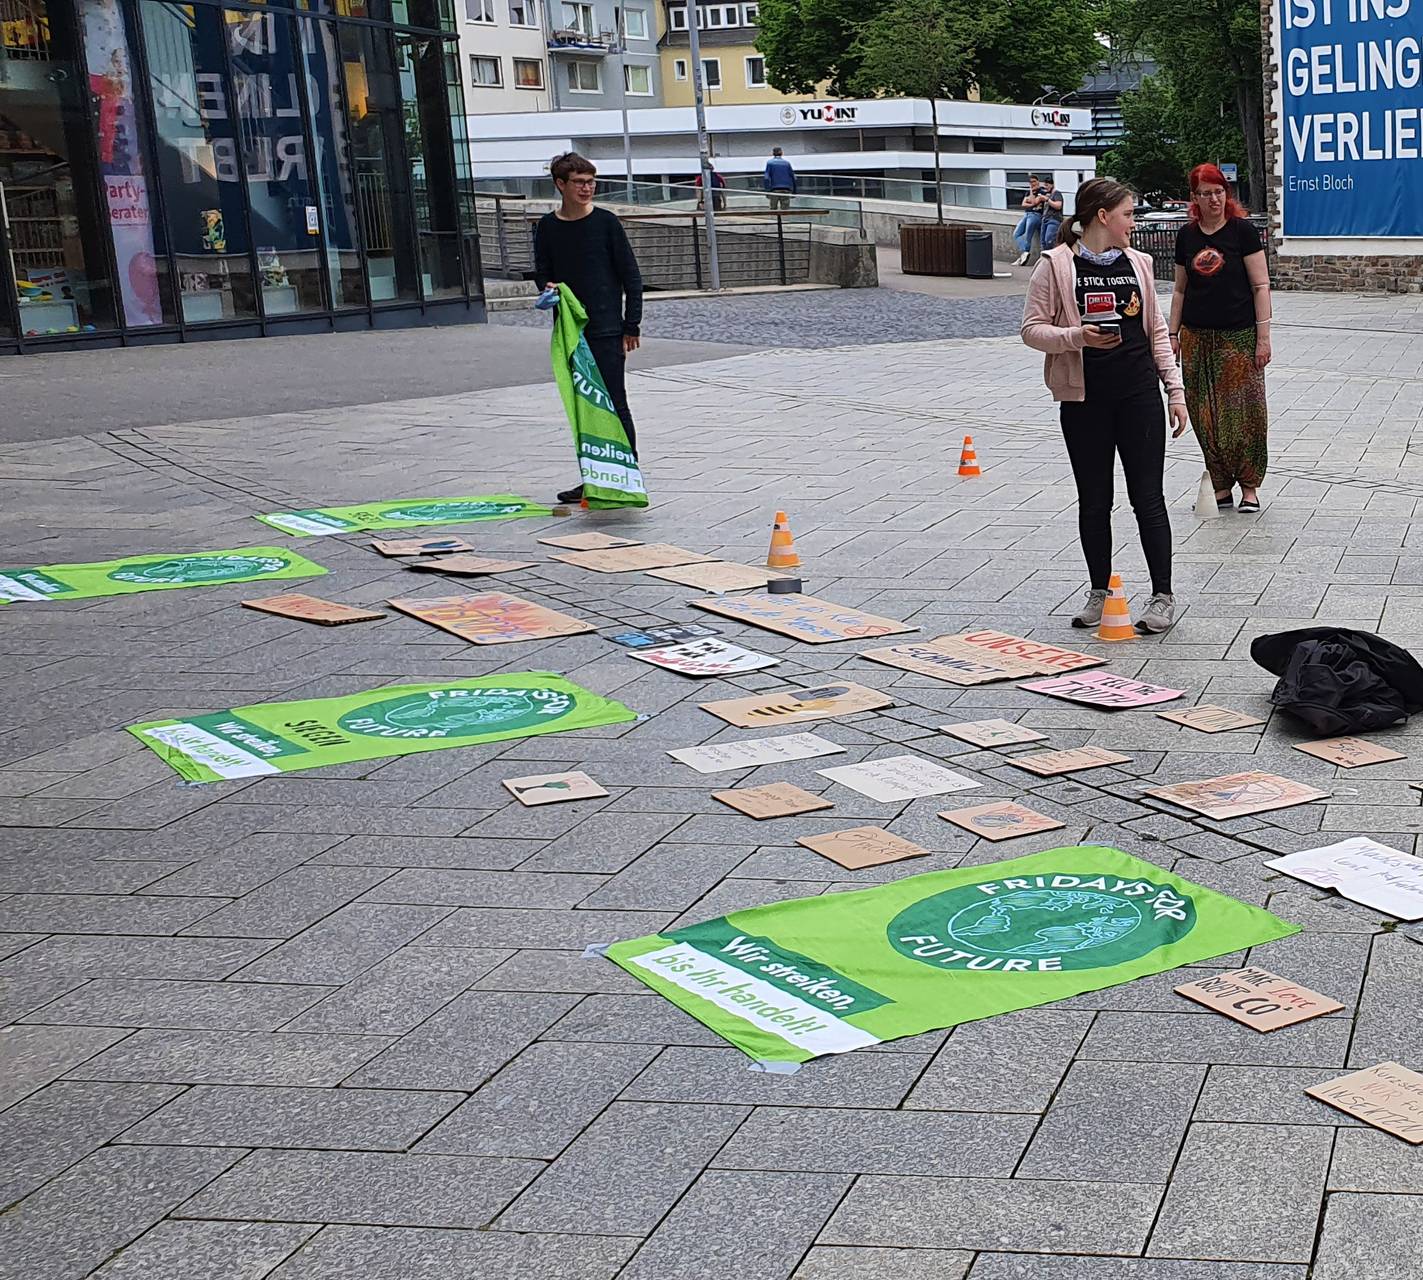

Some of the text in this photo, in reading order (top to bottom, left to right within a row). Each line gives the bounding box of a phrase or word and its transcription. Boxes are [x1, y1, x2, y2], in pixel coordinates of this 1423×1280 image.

[1289, 173, 1354, 193] Ernst Bloch
[1083, 277, 1105, 287] STICK
[891, 647, 1006, 674] SCHMILZT
[964, 633, 1101, 668] UNSERE
[1041, 681, 1137, 704] TRUTH
[1093, 677, 1134, 689] TELL
[976, 875, 1187, 921] FRIDAYS FOR
[899, 935, 1063, 972] FUTURE
[719, 936, 855, 1011] Wir streiken,
[1232, 968, 1280, 987] MAKE
[652, 952, 828, 1035] bis Ihr handelt!
[1195, 977, 1251, 998] NOT
[1360, 1083, 1403, 1103] NUR
